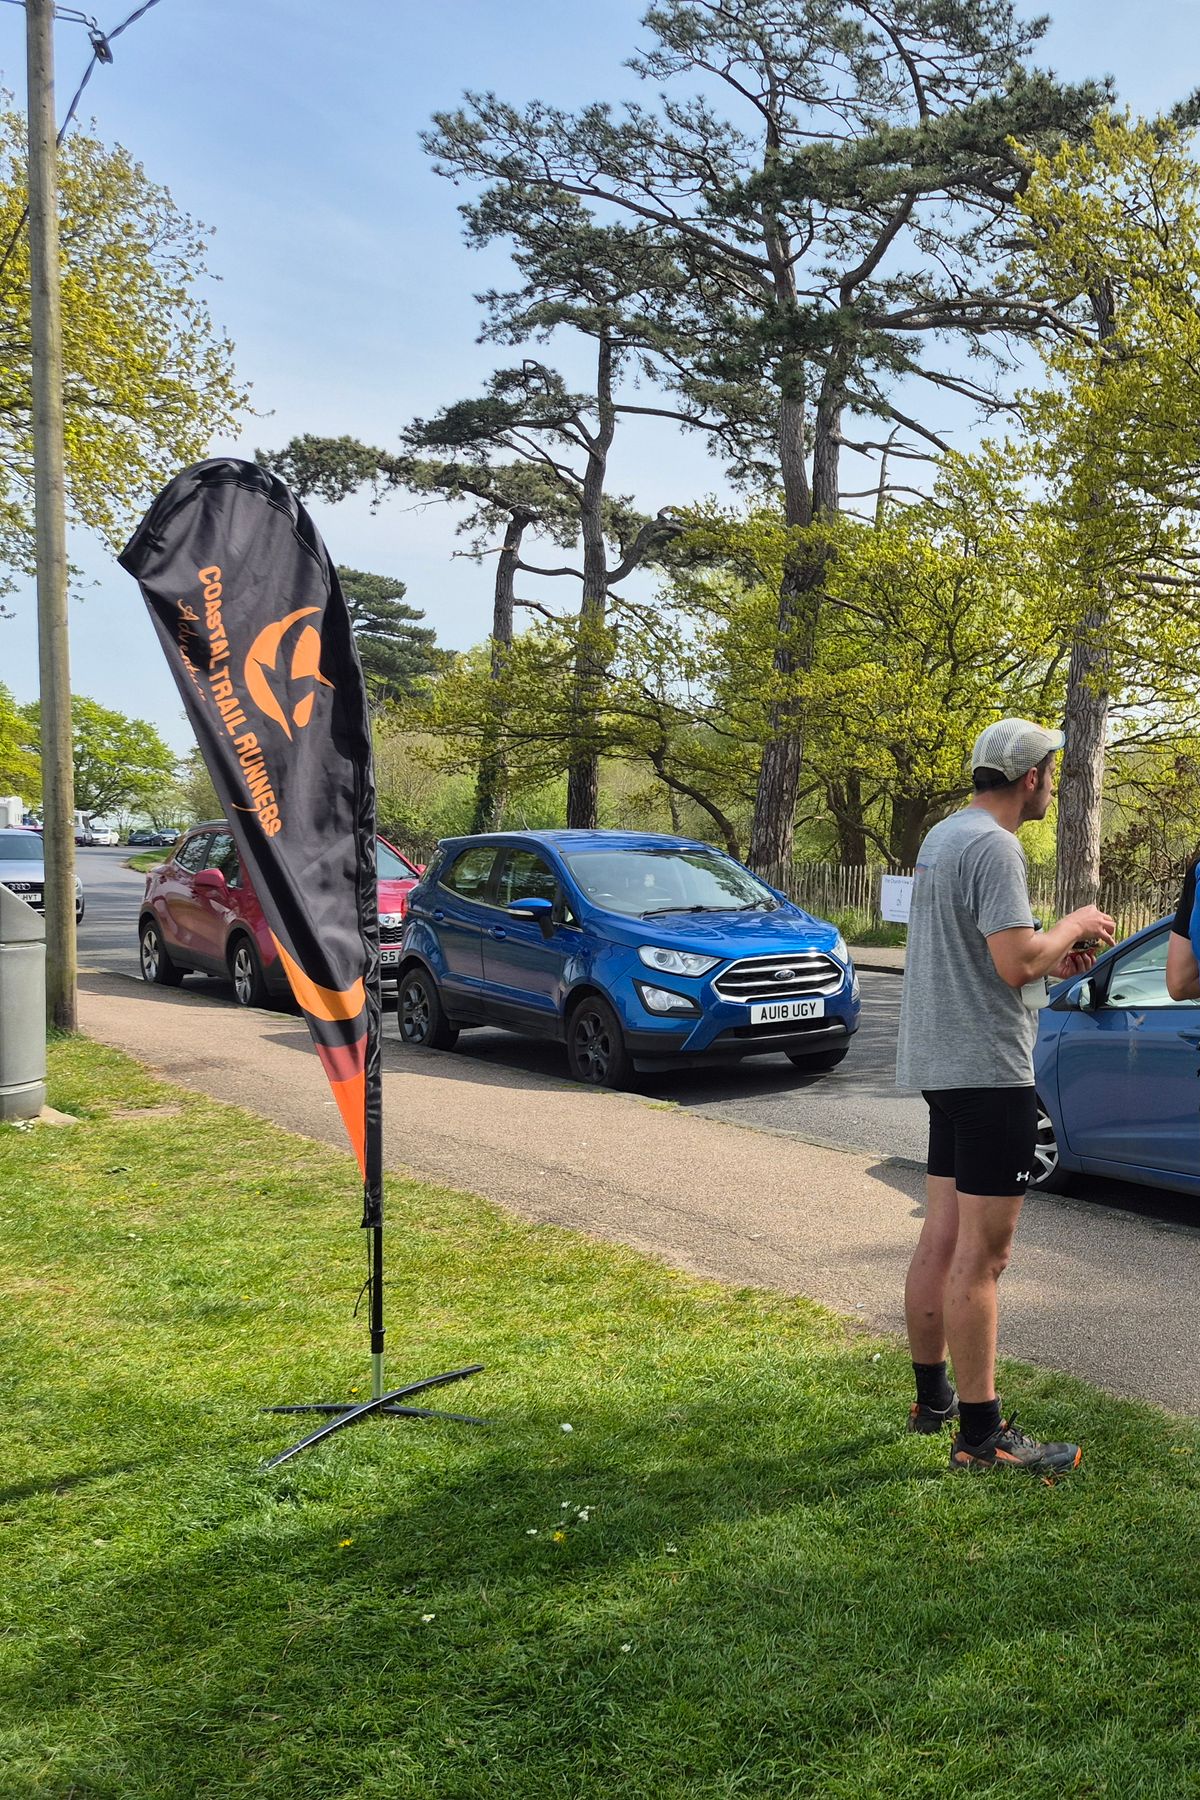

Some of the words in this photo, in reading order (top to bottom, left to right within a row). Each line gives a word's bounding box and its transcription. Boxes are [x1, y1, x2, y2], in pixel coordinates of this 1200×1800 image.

[198, 565, 231, 669] COASTAL
[208, 665, 248, 736] TRAIL
[381, 951, 396, 962] 65
[760, 1004, 789, 1021] AU18
[792, 1002, 817, 1017] UGY
